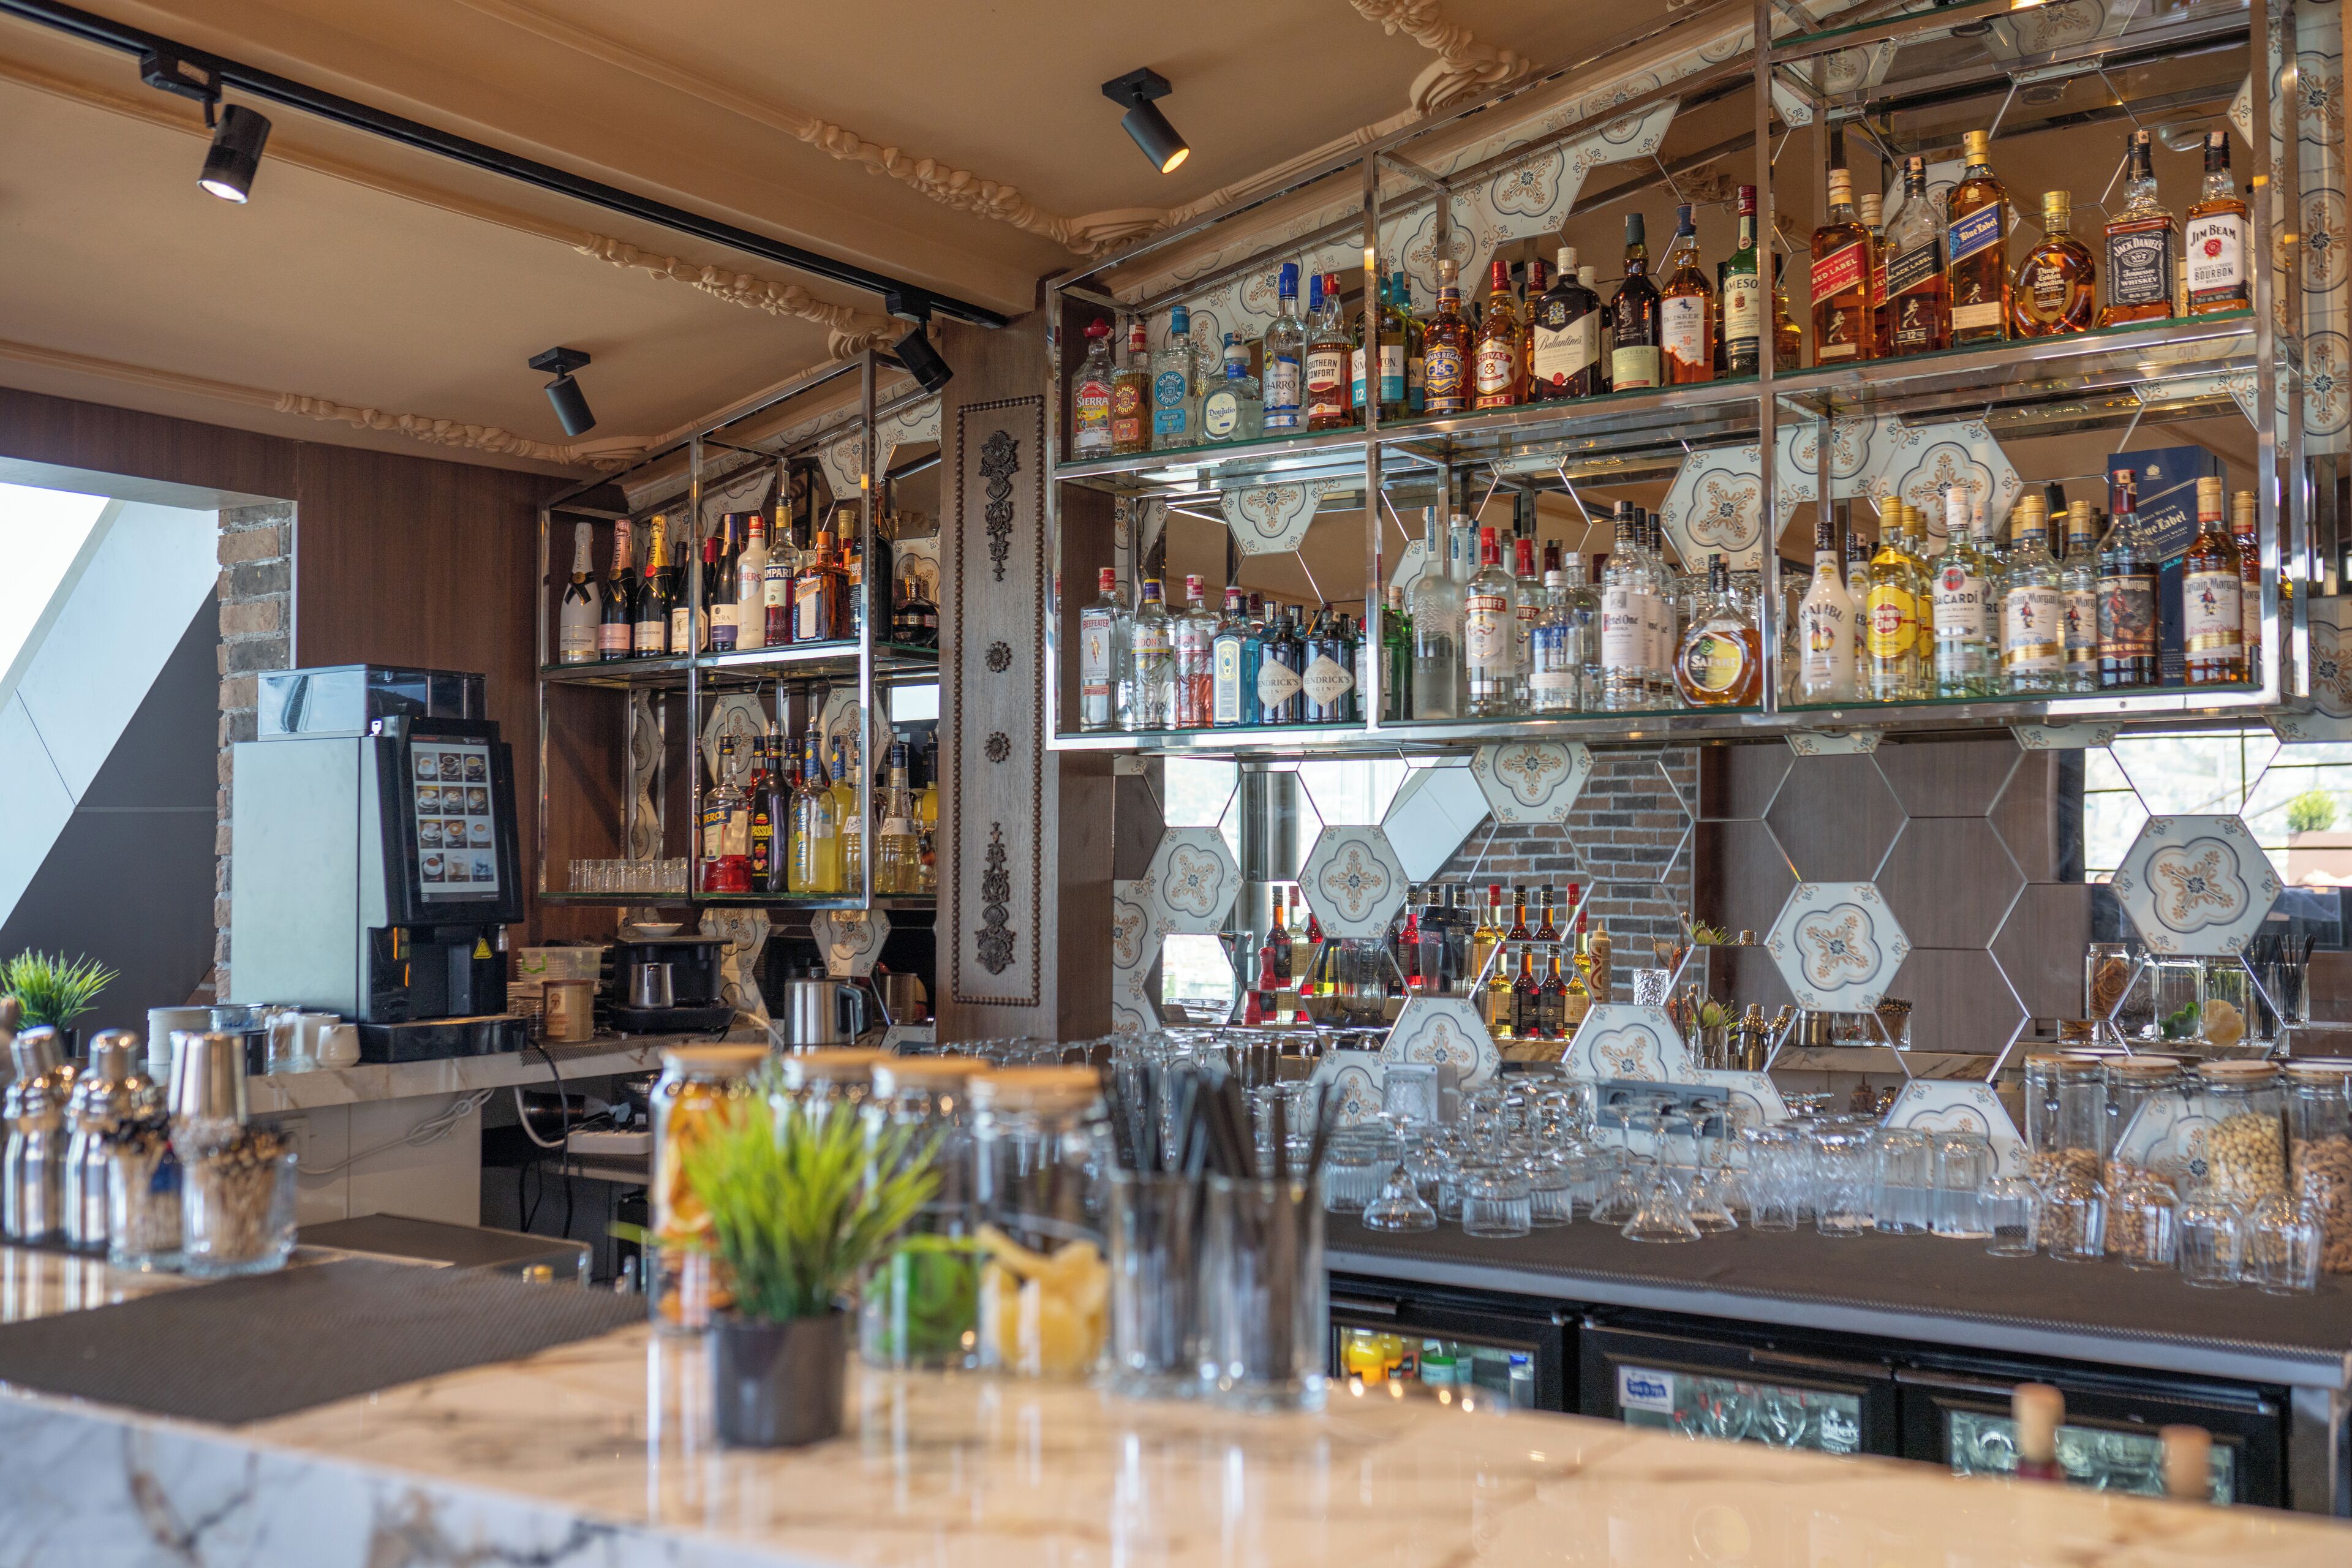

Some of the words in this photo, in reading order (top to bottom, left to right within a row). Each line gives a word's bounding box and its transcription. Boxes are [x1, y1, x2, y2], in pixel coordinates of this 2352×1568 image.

[1959, 229, 1978, 242] Blue
[1978, 217, 1998, 235] Label
[2190, 228, 2207, 247] JIM
[2209, 224, 2236, 240] BEAM
[2113, 241, 2134, 257] JACK
[2132, 238, 2164, 252] DANIEL'S
[1909, 251, 1929, 262] WALKER
[1812, 272, 1829, 285] RED
[1830, 258, 1858, 275] LABEL
[1888, 266, 1910, 281] BLACK
[1910, 255, 1935, 269] LABEL
[2037, 266, 2061, 276] Dimple
[2122, 269, 2155, 277] Tennessee
[2038, 273, 2062, 282] Golden
[2195, 267, 2233, 281] BOURBON
[2034, 279, 2065, 289] Selection
[2120, 277, 2158, 286] WHISKEY
[1664, 313, 1700, 323] TALISKER
[1536, 334, 1583, 352] Ballantine's
[1683, 336, 1691, 345] 10
[1425, 352, 1441, 366] CHIVAS
[1441, 352, 1463, 363] REGAL
[1477, 352, 1507, 363] CHIVAS
[1308, 359, 1338, 369] SOUTHERN
[1433, 363, 1446, 374] 18
[1308, 369, 1335, 379] COMFORT
[1158, 374, 1181, 386] OLMECA
[1116, 386, 1135, 397] OLMECA
[1355, 388, 1365, 402] 12
[1077, 397, 1109, 407] SIERRA
[1158, 391, 1182, 404] TEQUILA
[1116, 401, 1136, 413] TEQUILA
[2155, 505, 2177, 516] WALKER
[2155, 511, 2185, 532] Label
[2117, 578, 2150, 592] Morgan
[2209, 577, 2241, 592] Morgan
[2026, 592, 2057, 605] Morgan
[1801, 603, 1847, 622] MALIBU
[1871, 609, 1907, 619] Havana
[1083, 619, 1109, 629] BEEFEATER
[1874, 619, 1898, 630] Club
[2100, 643, 2124, 652] DARK
[1258, 679, 1299, 687] ENDRICK'S
